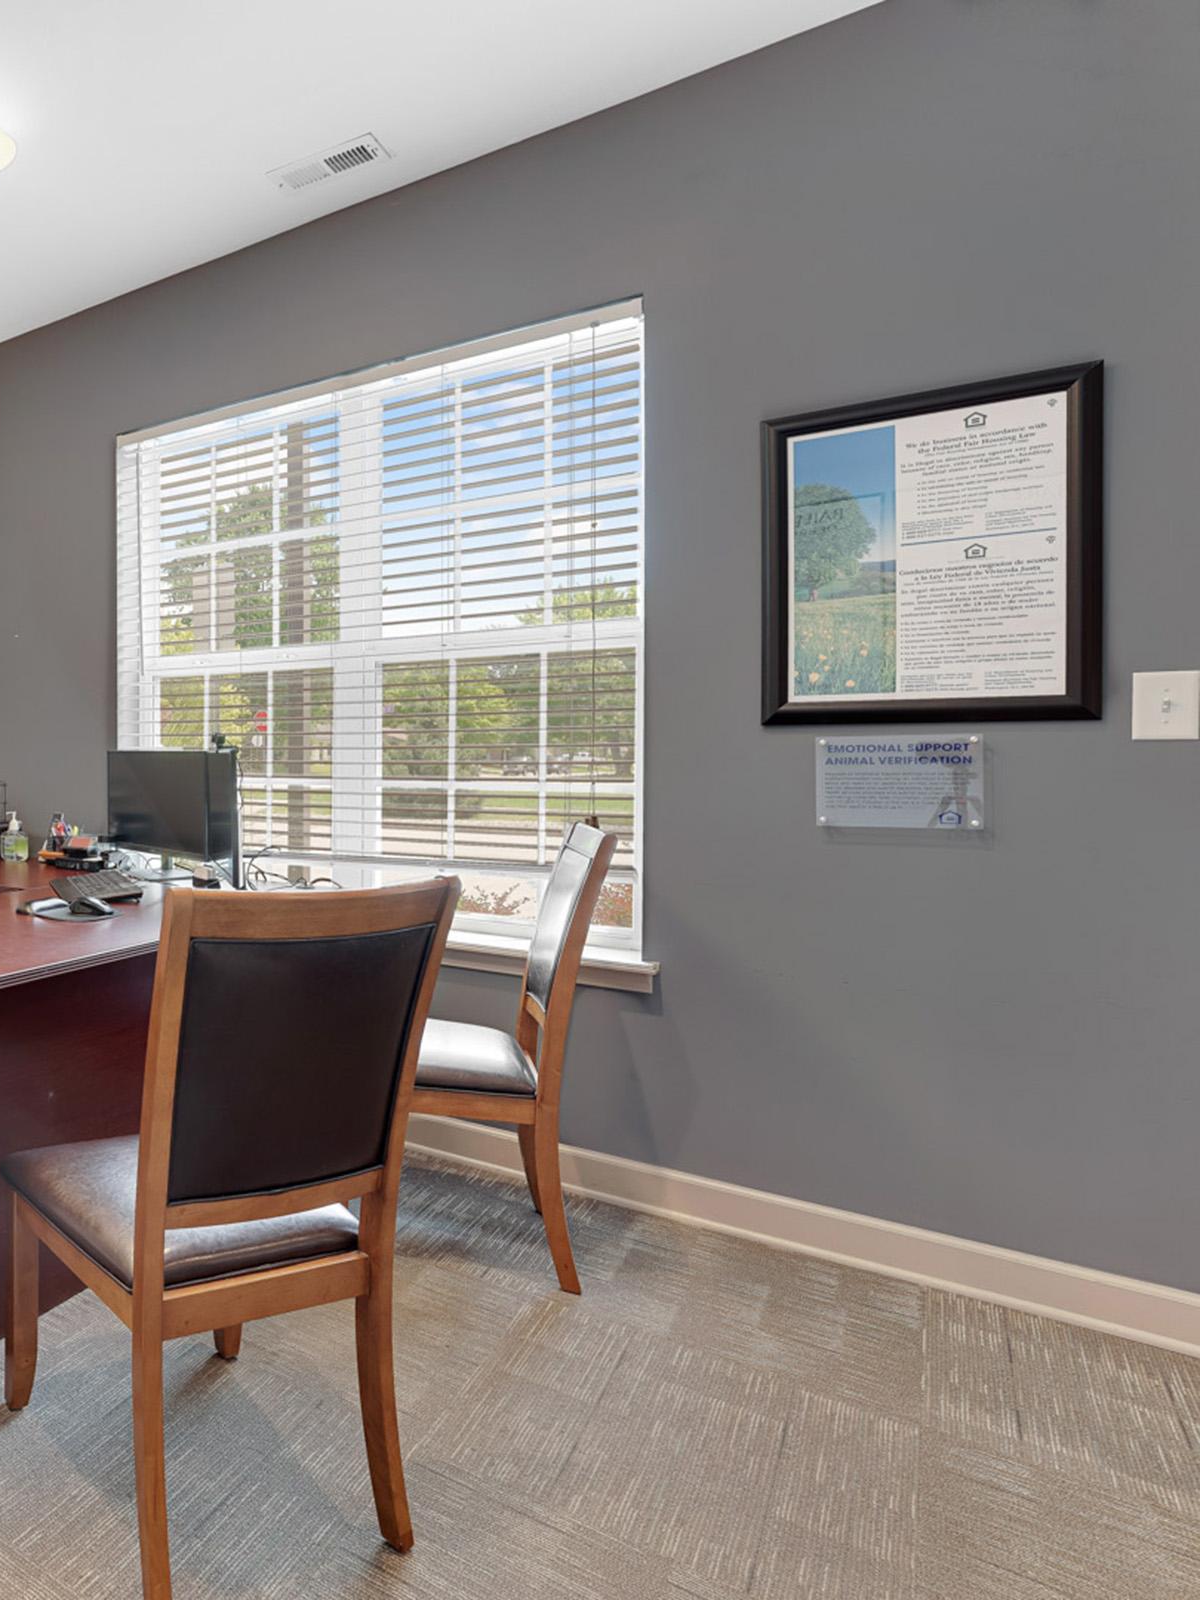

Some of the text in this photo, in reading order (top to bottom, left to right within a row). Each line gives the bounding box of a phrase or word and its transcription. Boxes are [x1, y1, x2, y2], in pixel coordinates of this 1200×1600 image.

[932, 434, 967, 445] business
[979, 426, 1025, 438] accordance
[932, 443, 961, 451] Federal
[964, 439, 979, 447] Fair
[981, 434, 1017, 444] Housing
[827, 742, 970, 754] EMOTIONAL SUPPORT
[825, 755, 973, 765] ANIMAL VERIFICATION
